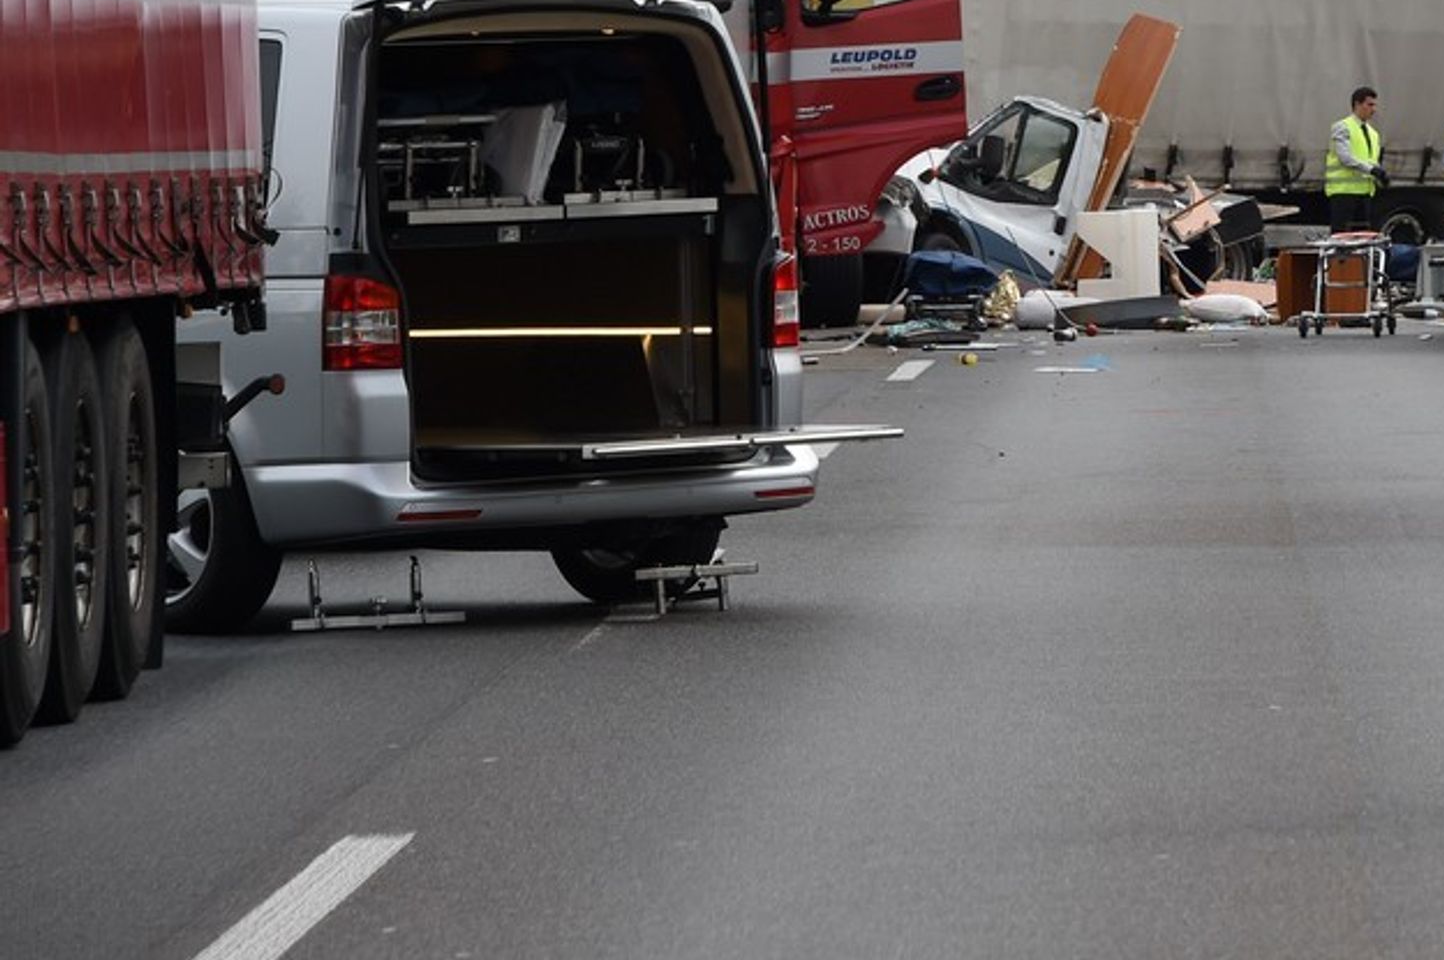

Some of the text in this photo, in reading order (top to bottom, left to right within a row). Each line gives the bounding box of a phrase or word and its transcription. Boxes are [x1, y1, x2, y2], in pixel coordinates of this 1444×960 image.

[831, 48, 917, 65] LEUPOLD
[803, 204, 871, 230] ACTROS
[833, 236, 861, 252] 150
